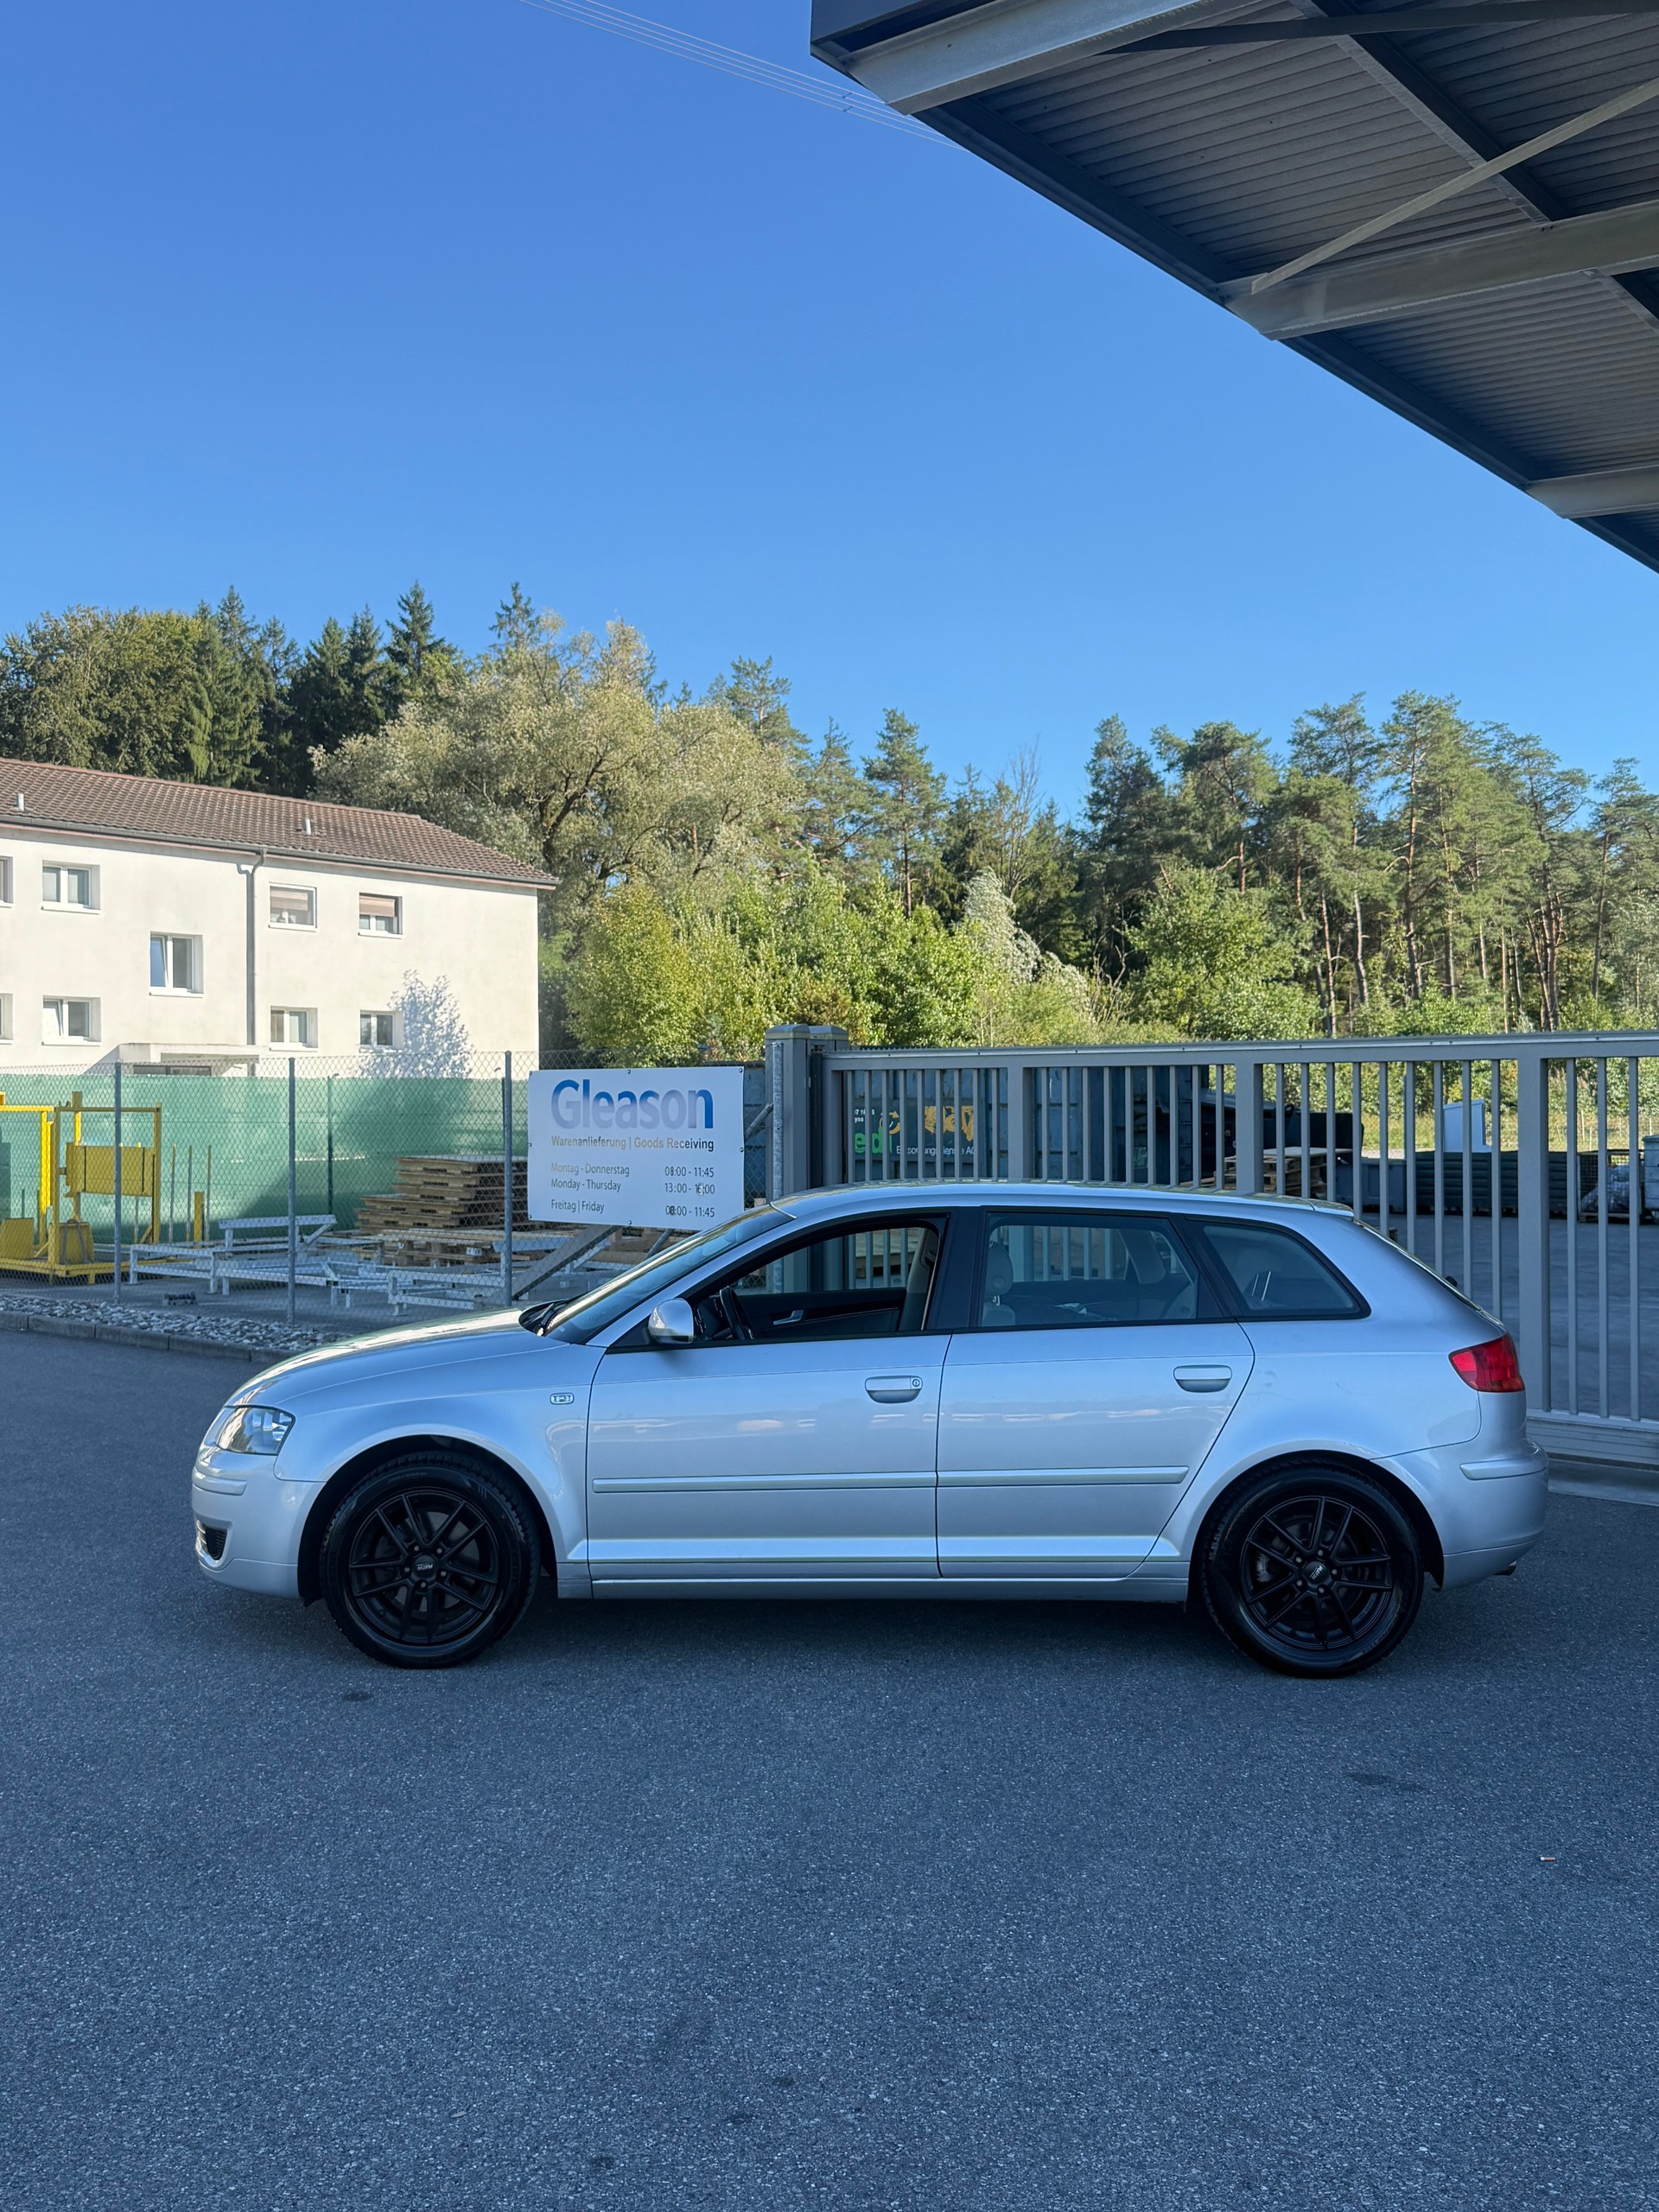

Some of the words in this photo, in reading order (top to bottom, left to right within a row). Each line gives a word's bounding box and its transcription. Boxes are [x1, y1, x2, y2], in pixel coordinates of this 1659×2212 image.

[550, 1078, 714, 1129] Gleason
[551, 1135, 626, 1150] Warenanlieferung
[634, 1136, 664, 1148] Goods
[666, 1137, 715, 1152] Receiving
[550, 1162, 580, 1176] Montag
[585, 1163, 630, 1177] Donnerstag
[664, 1166, 687, 1176] 08:00
[694, 1166, 715, 1178] 11:45
[551, 1178, 581, 1191] Monday
[586, 1179, 621, 1192] Thursday
[664, 1182, 688, 1193] 13:00
[551, 1199, 576, 1212] Freitag
[582, 1200, 605, 1214] Friday
[665, 1205, 687, 1216] 08:00
[695, 1206, 715, 1217] 11:45
